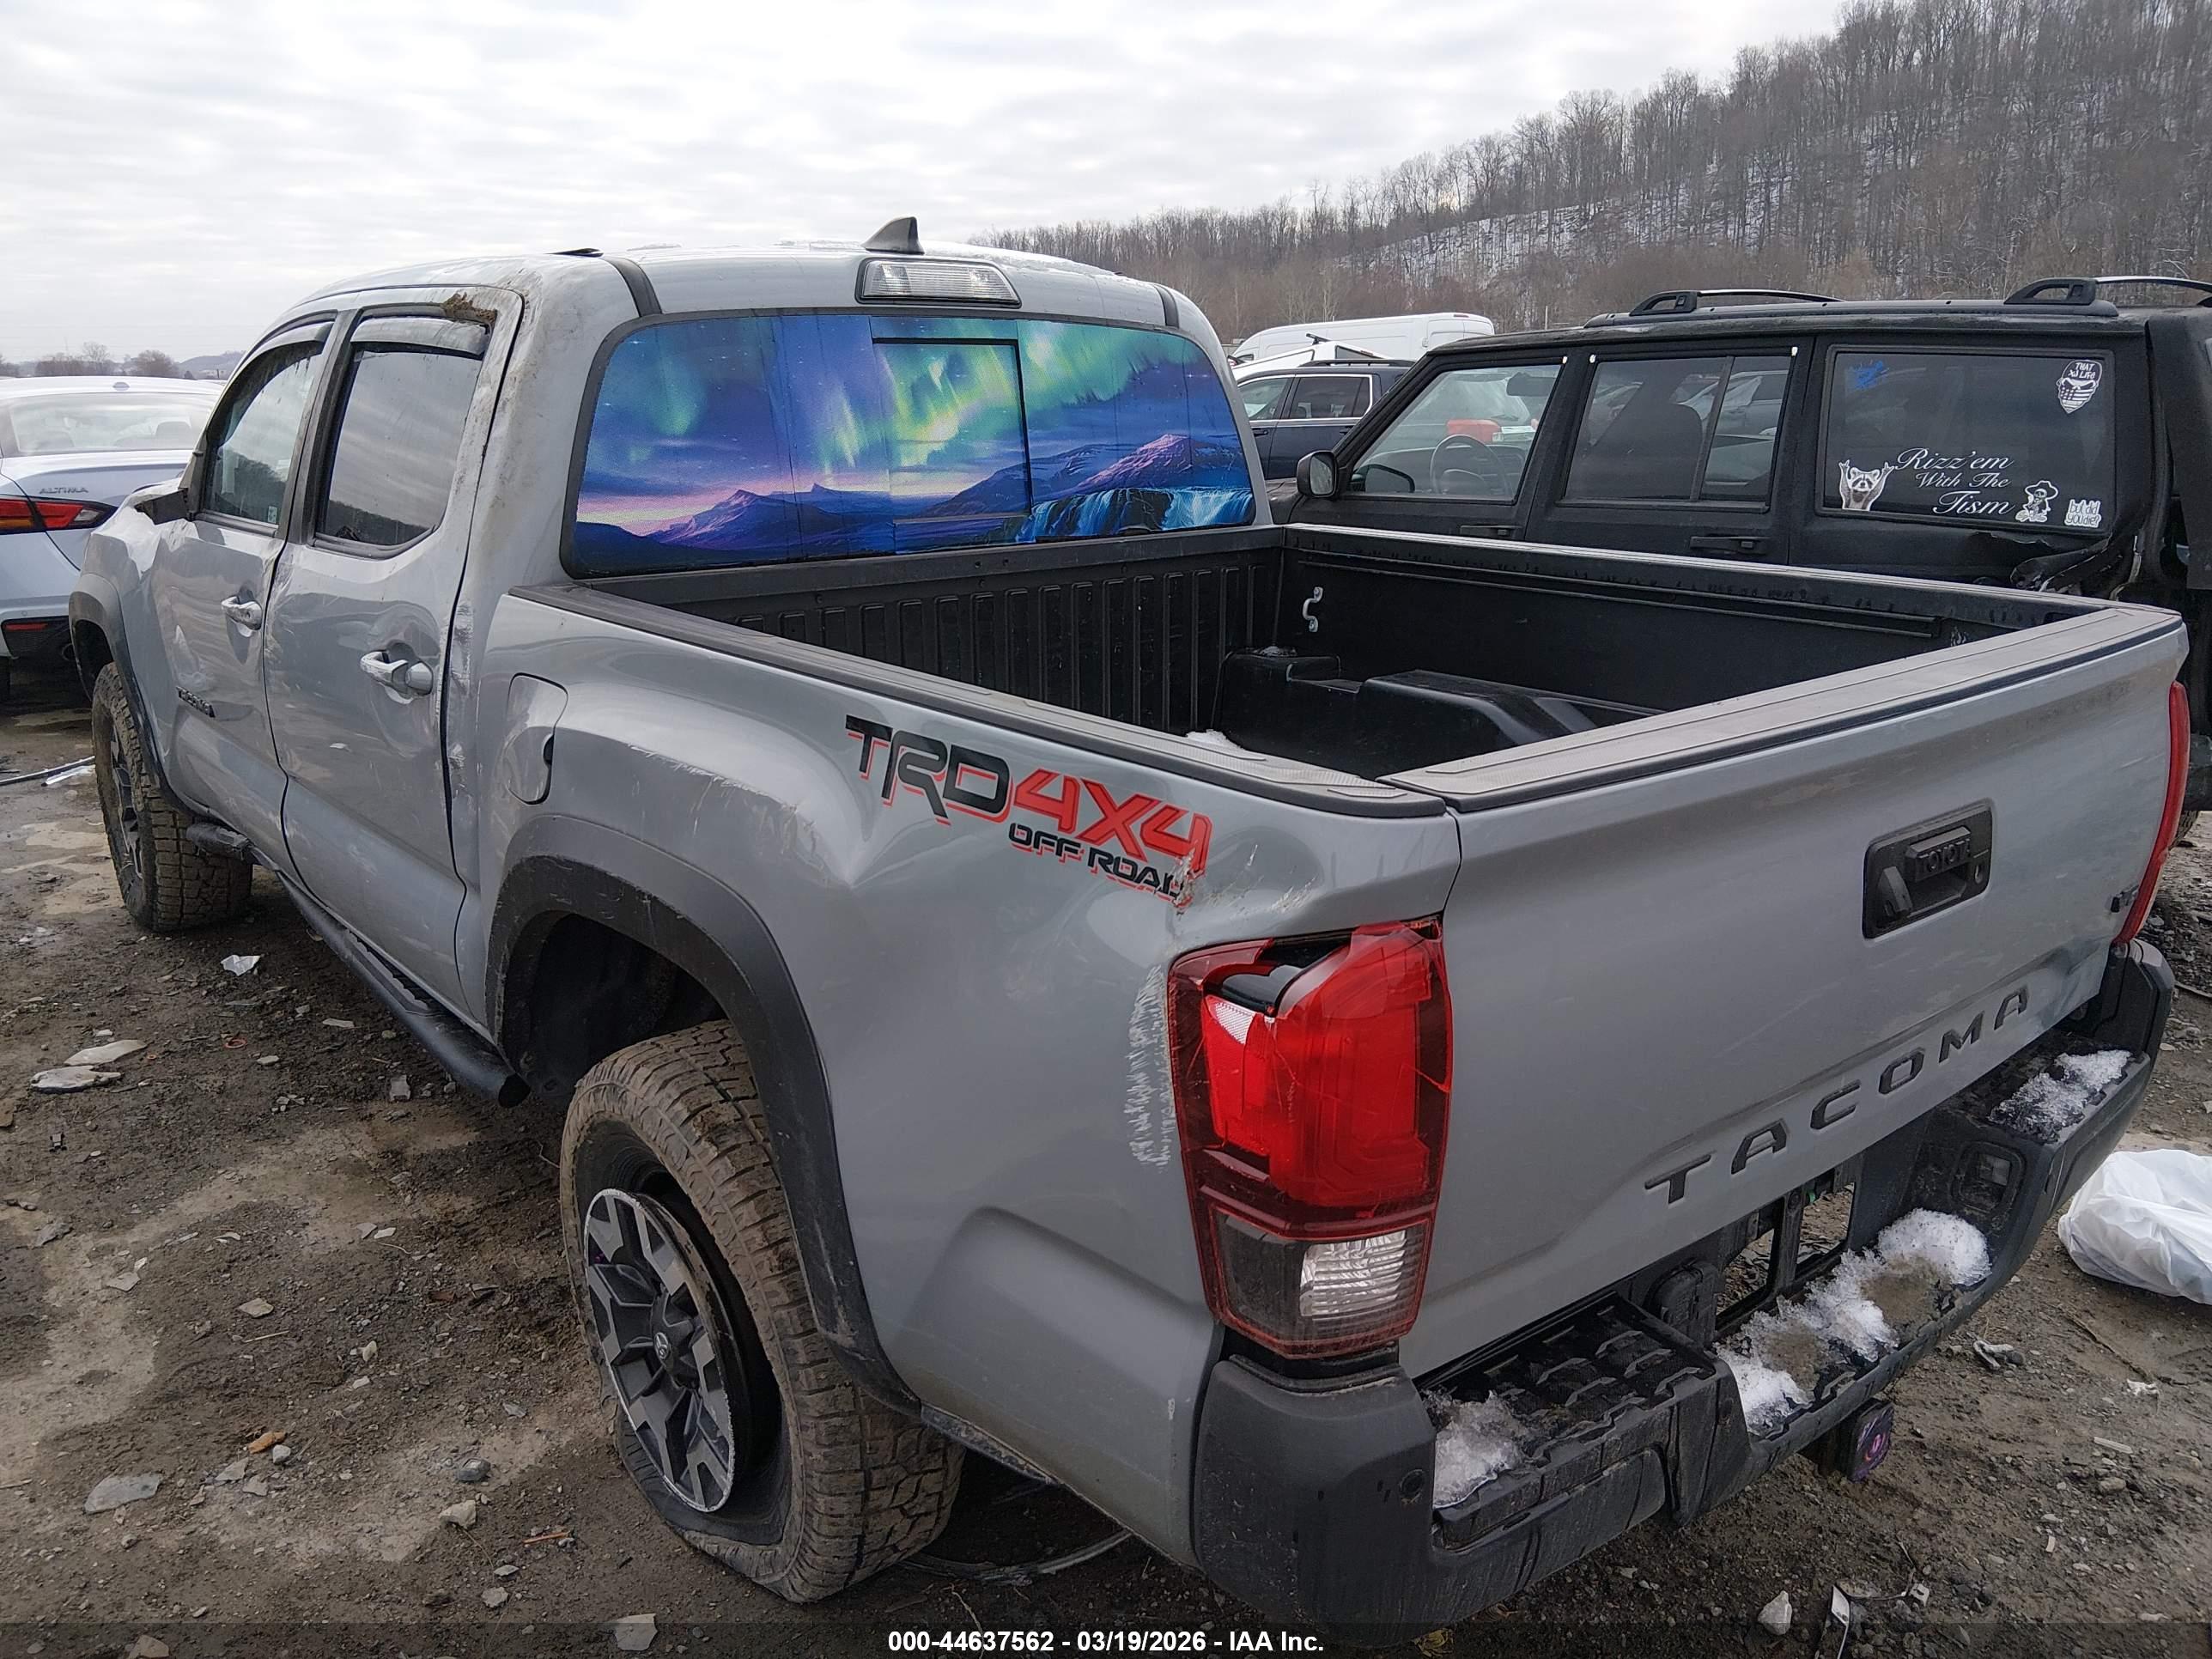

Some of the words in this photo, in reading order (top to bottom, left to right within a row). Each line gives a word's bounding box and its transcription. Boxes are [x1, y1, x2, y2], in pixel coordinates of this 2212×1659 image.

[2075, 362, 2095, 372] THAT
[1894, 447, 2014, 470] Rizz'em
[1915, 471, 1963, 488] With
[1968, 472, 2011, 488] The
[1932, 490, 2016, 514] Tism
[845, 714, 1013, 826] TRD
[1008, 822, 1085, 863] OFF
[1644, 985, 2030, 1204] TACOMA
